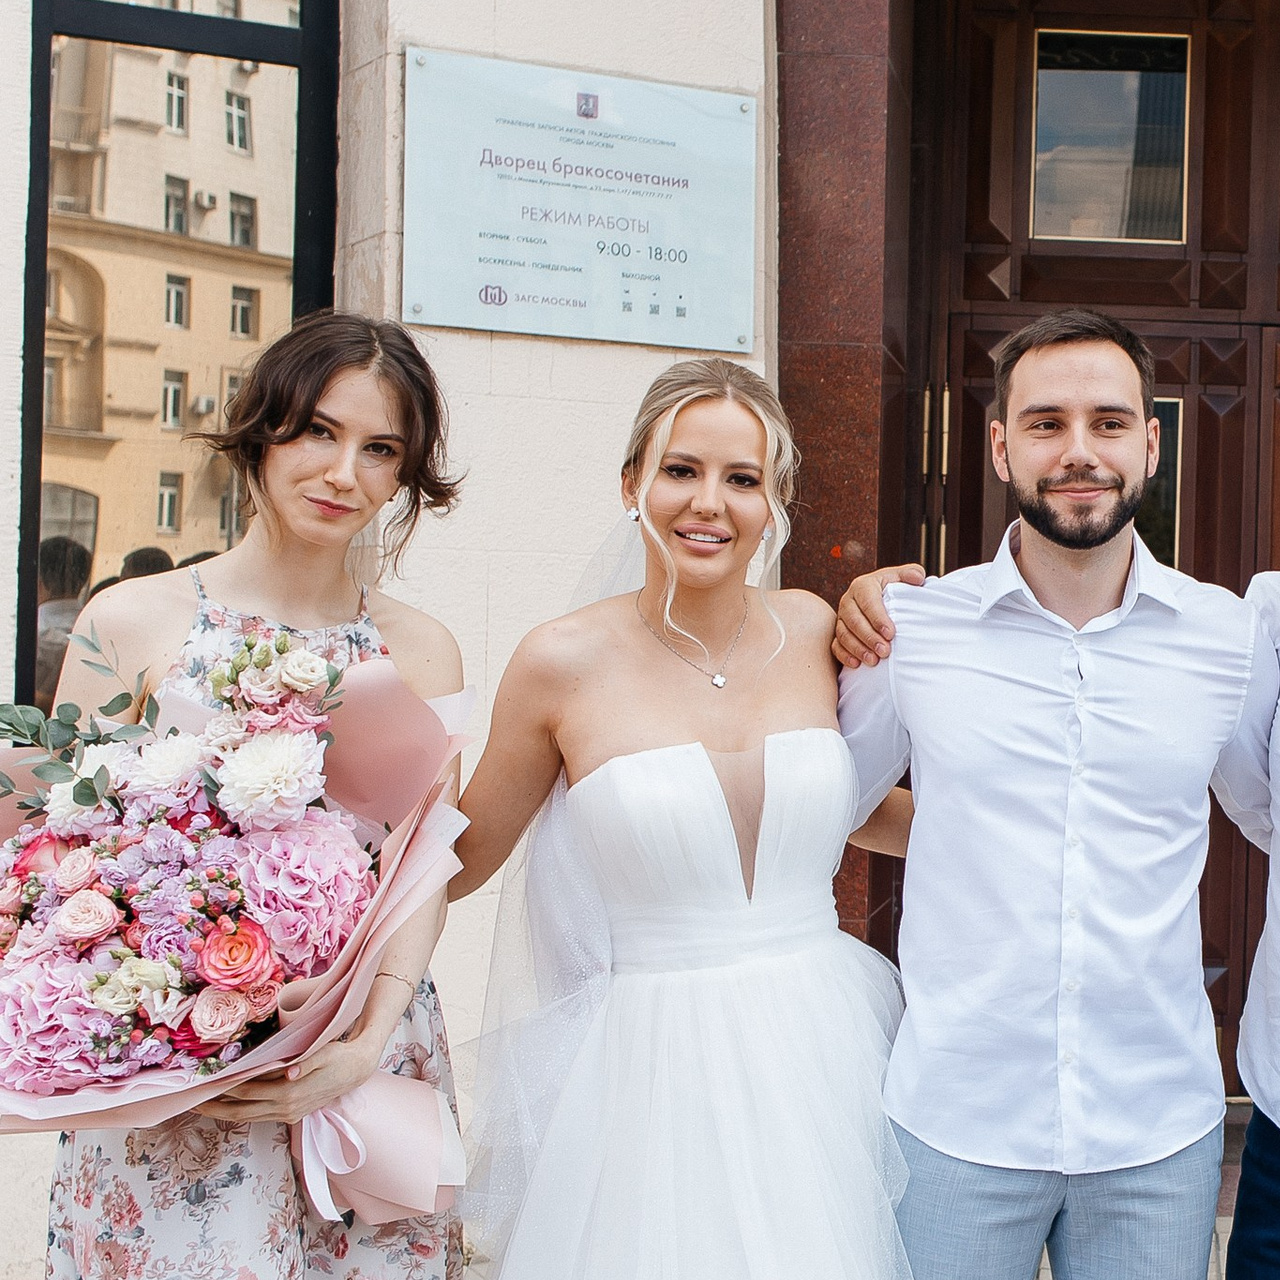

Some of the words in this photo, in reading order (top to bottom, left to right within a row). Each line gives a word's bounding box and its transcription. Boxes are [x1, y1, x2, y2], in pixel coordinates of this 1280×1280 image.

[479, 148, 547, 174] Дворец
[552, 157, 690, 189] бракосочетания
[521, 206, 582, 226] РЕЖИМ
[587, 213, 649, 234] РАБОТЫ
[478, 231, 511, 241] ВТОРНИК
[516, 235, 548, 245] СУББОТА
[596, 240, 632, 258] 9:00
[648, 246, 688, 263] 18:00
[478, 256, 526, 268] ВОСКРЕСЕНЬЕ
[531, 261, 583, 273] ПОНЕДЕЛЬНИК
[621, 271, 661, 281] ВЫХОДНОЙ
[514, 293, 539, 304] ЗАГС
[541, 296, 588, 308] МОСКВЫ
